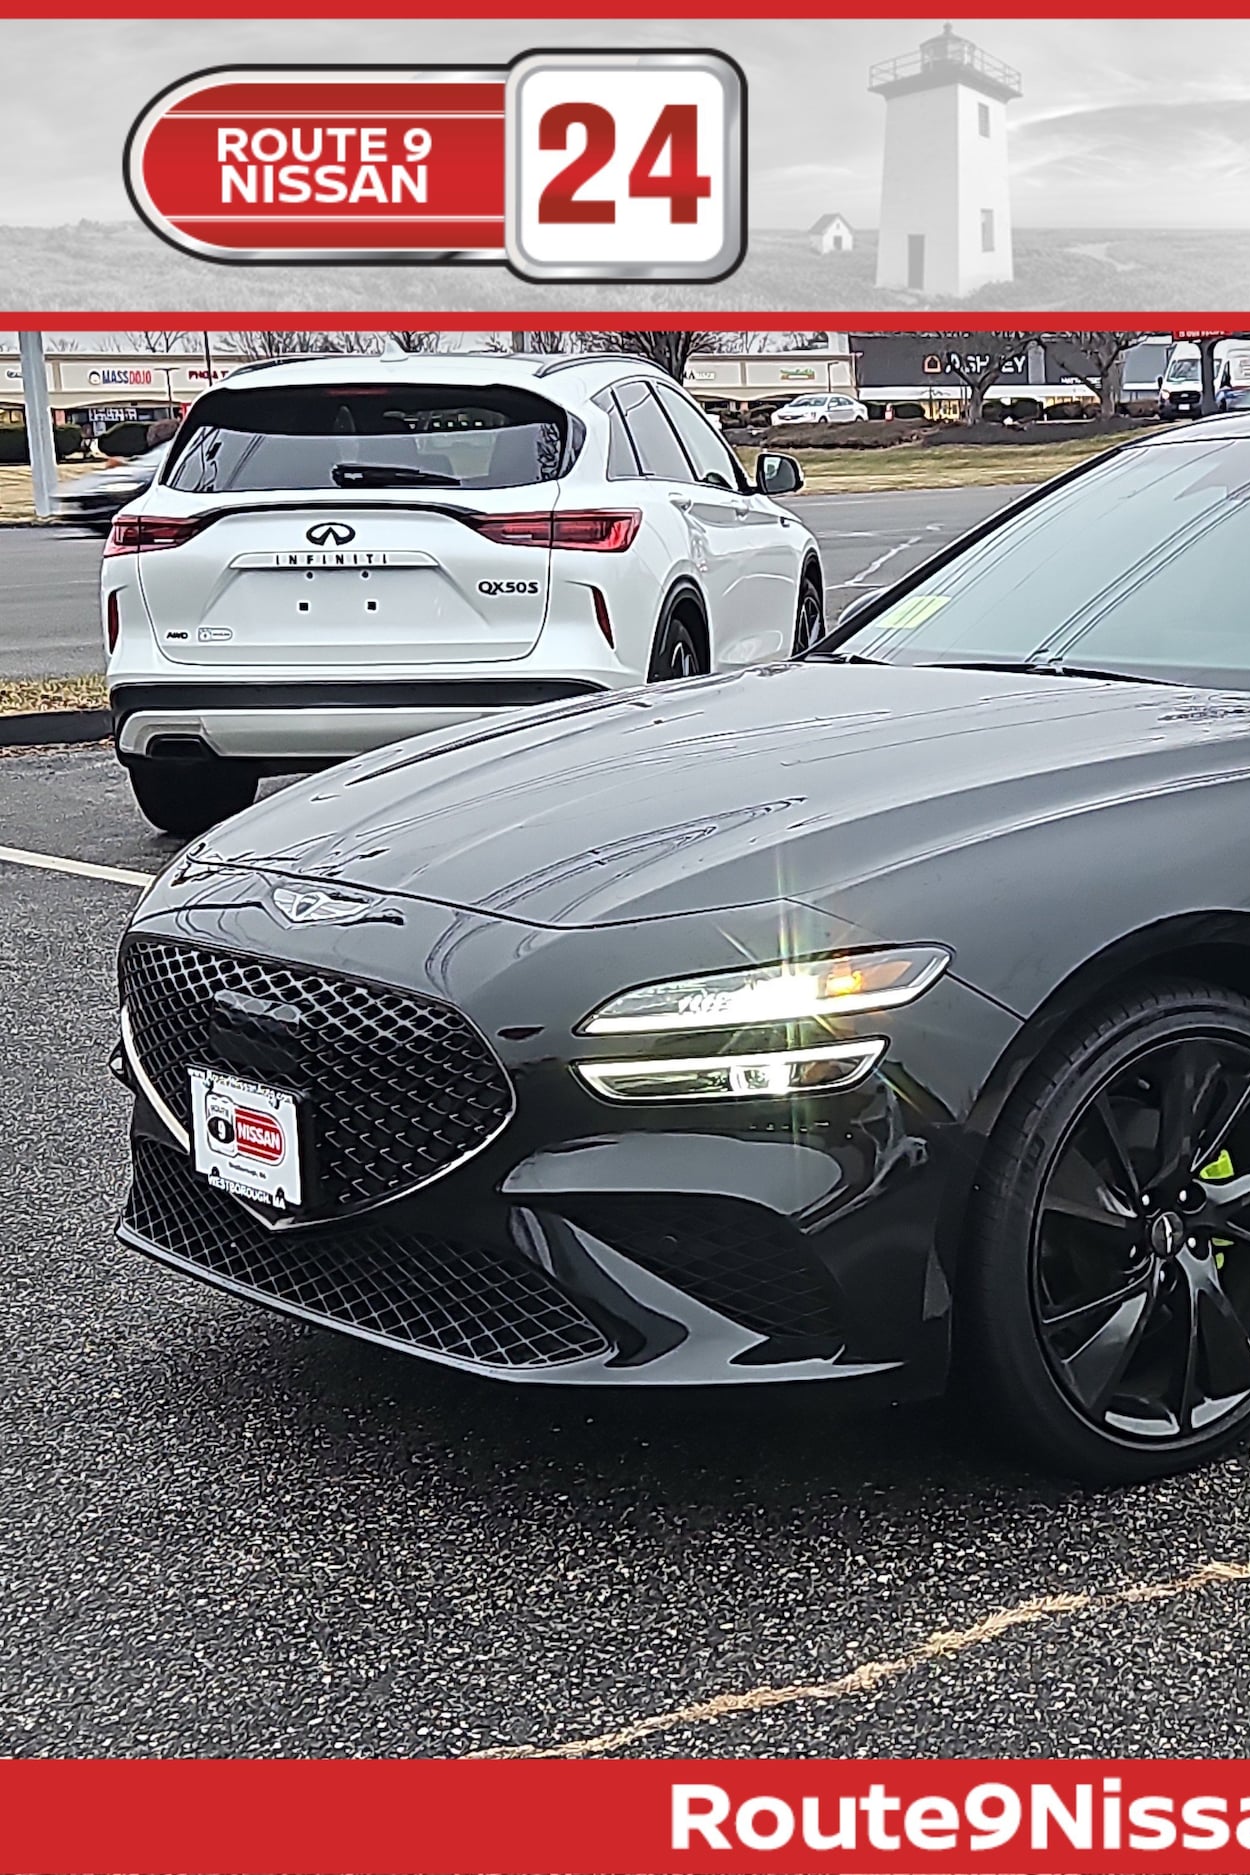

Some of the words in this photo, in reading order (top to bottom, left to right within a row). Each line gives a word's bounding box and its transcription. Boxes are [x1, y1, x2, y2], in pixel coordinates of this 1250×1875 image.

[276, 554, 387, 565] INFINITI
[478, 581, 539, 596] QX50S
[217, 1120, 226, 1140] 9
[237, 1122, 281, 1150] NISSAN
